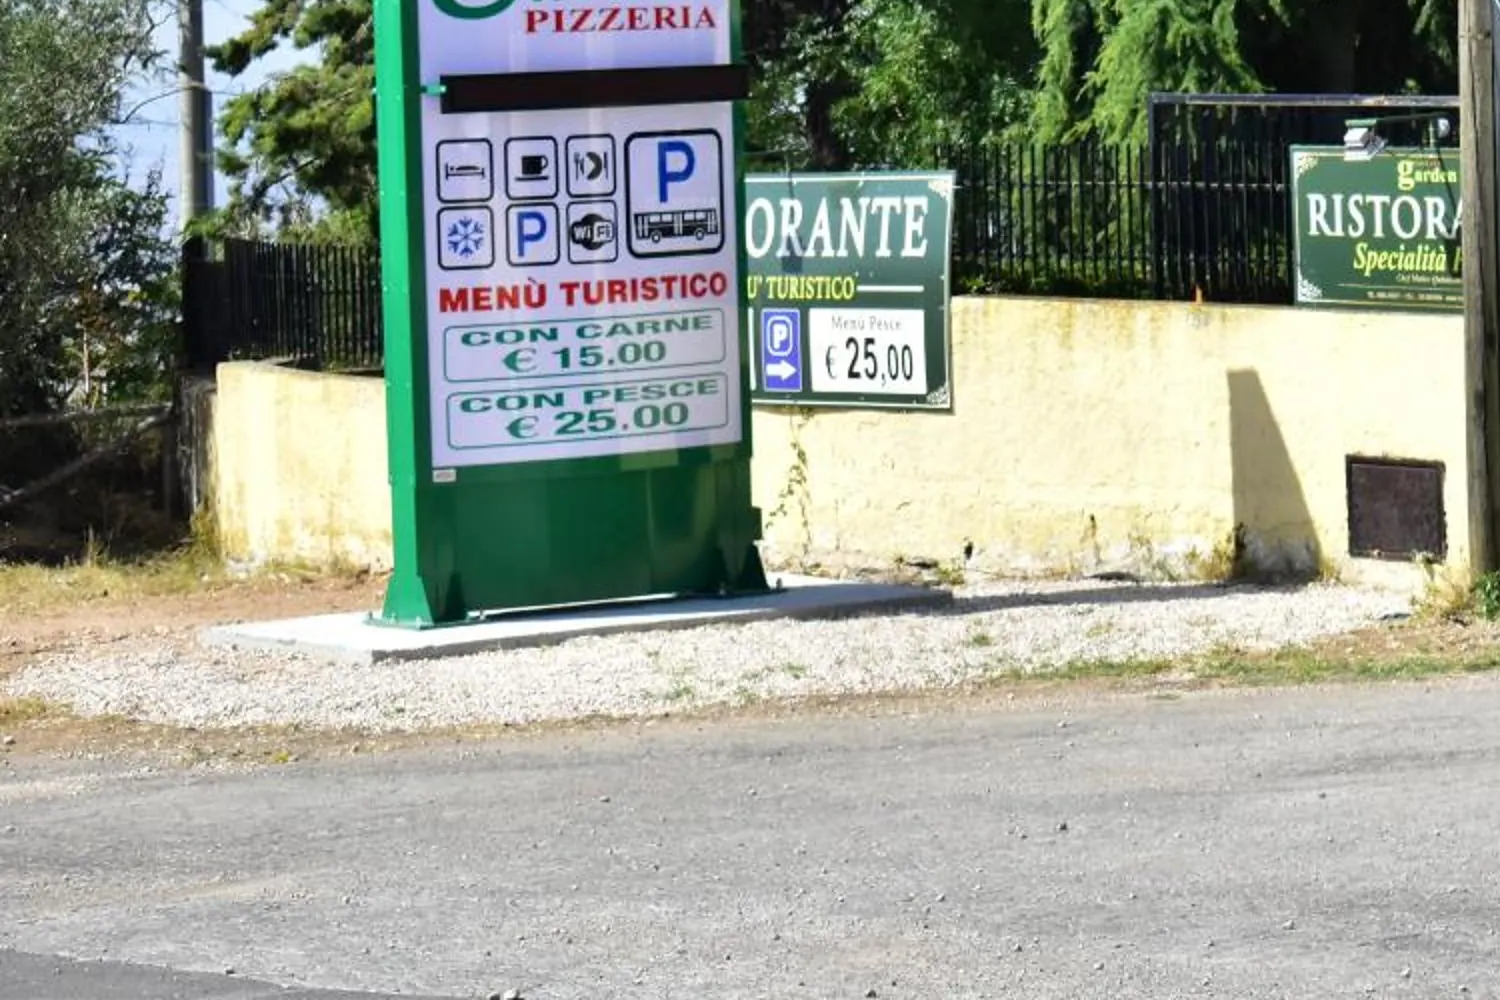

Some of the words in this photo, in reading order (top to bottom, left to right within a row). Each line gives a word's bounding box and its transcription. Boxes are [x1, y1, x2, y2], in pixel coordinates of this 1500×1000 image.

[525, 6, 717, 34] PIZZERIA
[1353, 242, 1447, 277] Specialità
[439, 277, 547, 313] MENÙ
[559, 271, 728, 307] TURISTICO
[765, 275, 855, 300] TURISTICO
[460, 327, 559, 347] CON
[575, 314, 714, 340] CARNE
[869, 315, 902, 330] Pesce
[551, 340, 667, 370] 15.00
[459, 392, 565, 414] CON
[583, 378, 720, 405] PESCE
[554, 401, 690, 437] 25.00
